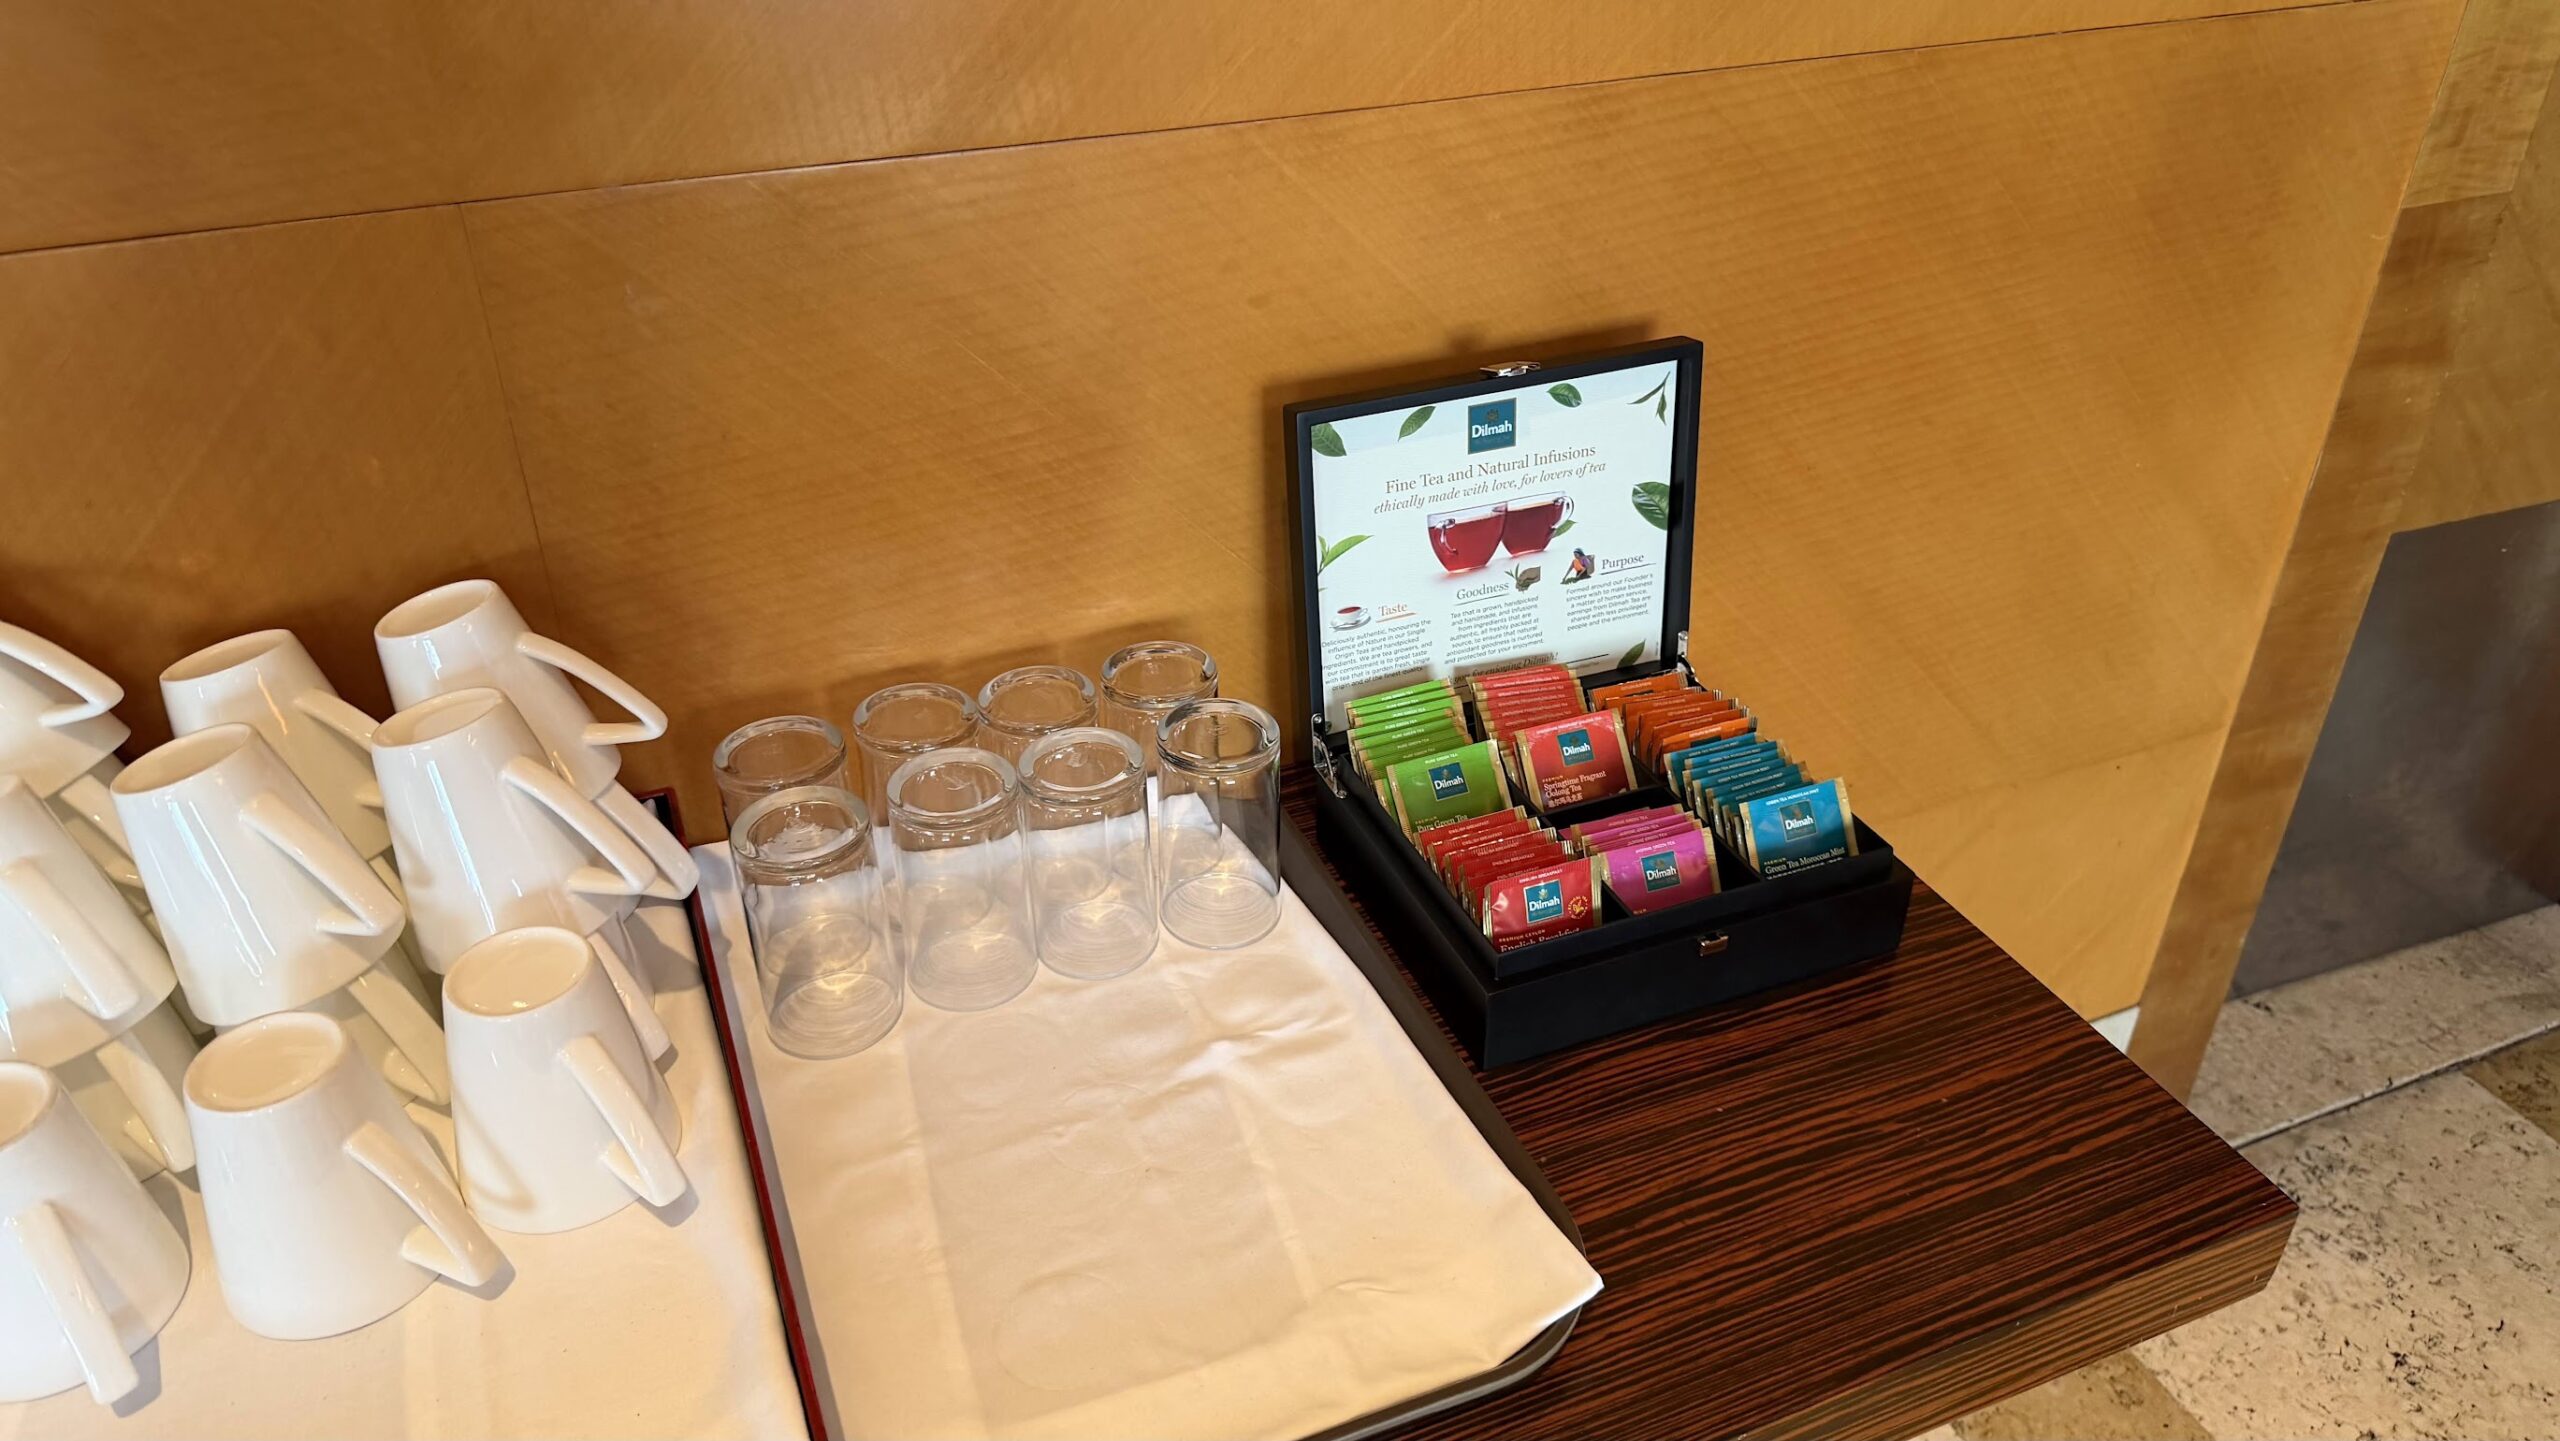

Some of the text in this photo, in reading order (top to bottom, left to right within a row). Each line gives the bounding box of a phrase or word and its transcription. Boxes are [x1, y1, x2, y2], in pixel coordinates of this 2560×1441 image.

[1471, 420, 1512, 438] Dilmah
[1386, 446, 1596, 494] Fine Tea and Natural Infusions
[1374, 463, 1606, 514] ethically made with love, for lovers of tea
[1602, 555, 1644, 569] Purpose
[1457, 583, 1509, 600] Goodness
[1378, 603, 1408, 616] Taste
[1462, 608, 1474, 616] that
[1504, 595, 1538, 607] handpicked
[1512, 605, 1537, 613] infusions
[1609, 599, 1629, 607] Dilmah
[1474, 618, 1506, 628] ingredients
[1568, 623, 1587, 632] people
[1322, 636, 1354, 647] Deliciously
[1388, 623, 1419, 633] honouring
[1328, 644, 1355, 653] influence
[1366, 637, 1386, 645] Nature
[1335, 651, 1354, 659] Origin
[1371, 644, 1382, 652] and
[1384, 637, 1419, 649] handpicked
[1421, 641, 1432, 649] and
[1446, 645, 1479, 656] antioxidant
[1481, 640, 1509, 650] goodness
[1518, 631, 1542, 641] nurtured
[1340, 660, 1378, 673] commitment
[1395, 654, 1410, 663] great
[1457, 650, 1486, 662] protected
[1372, 666, 1393, 675] garden
[1563, 743, 1590, 756] Dilmah
[1434, 777, 1464, 790] Dilmah
[1544, 771, 1606, 791] Springtime Fragrant
[1546, 784, 1582, 798] Oolong Tea
[1417, 814, 1468, 833] Pure Green Tea
[1785, 815, 1813, 830] Dilmah
[1765, 864, 1786, 874] Green
[1787, 860, 1799, 870] Tea
[1800, 854, 1830, 867] Moroccan
[1830, 847, 1845, 858] Mint
[1646, 866, 1676, 881] Dilmah
[1528, 897, 1560, 912] Dilmah
[1525, 929, 1546, 937] CEYLON
